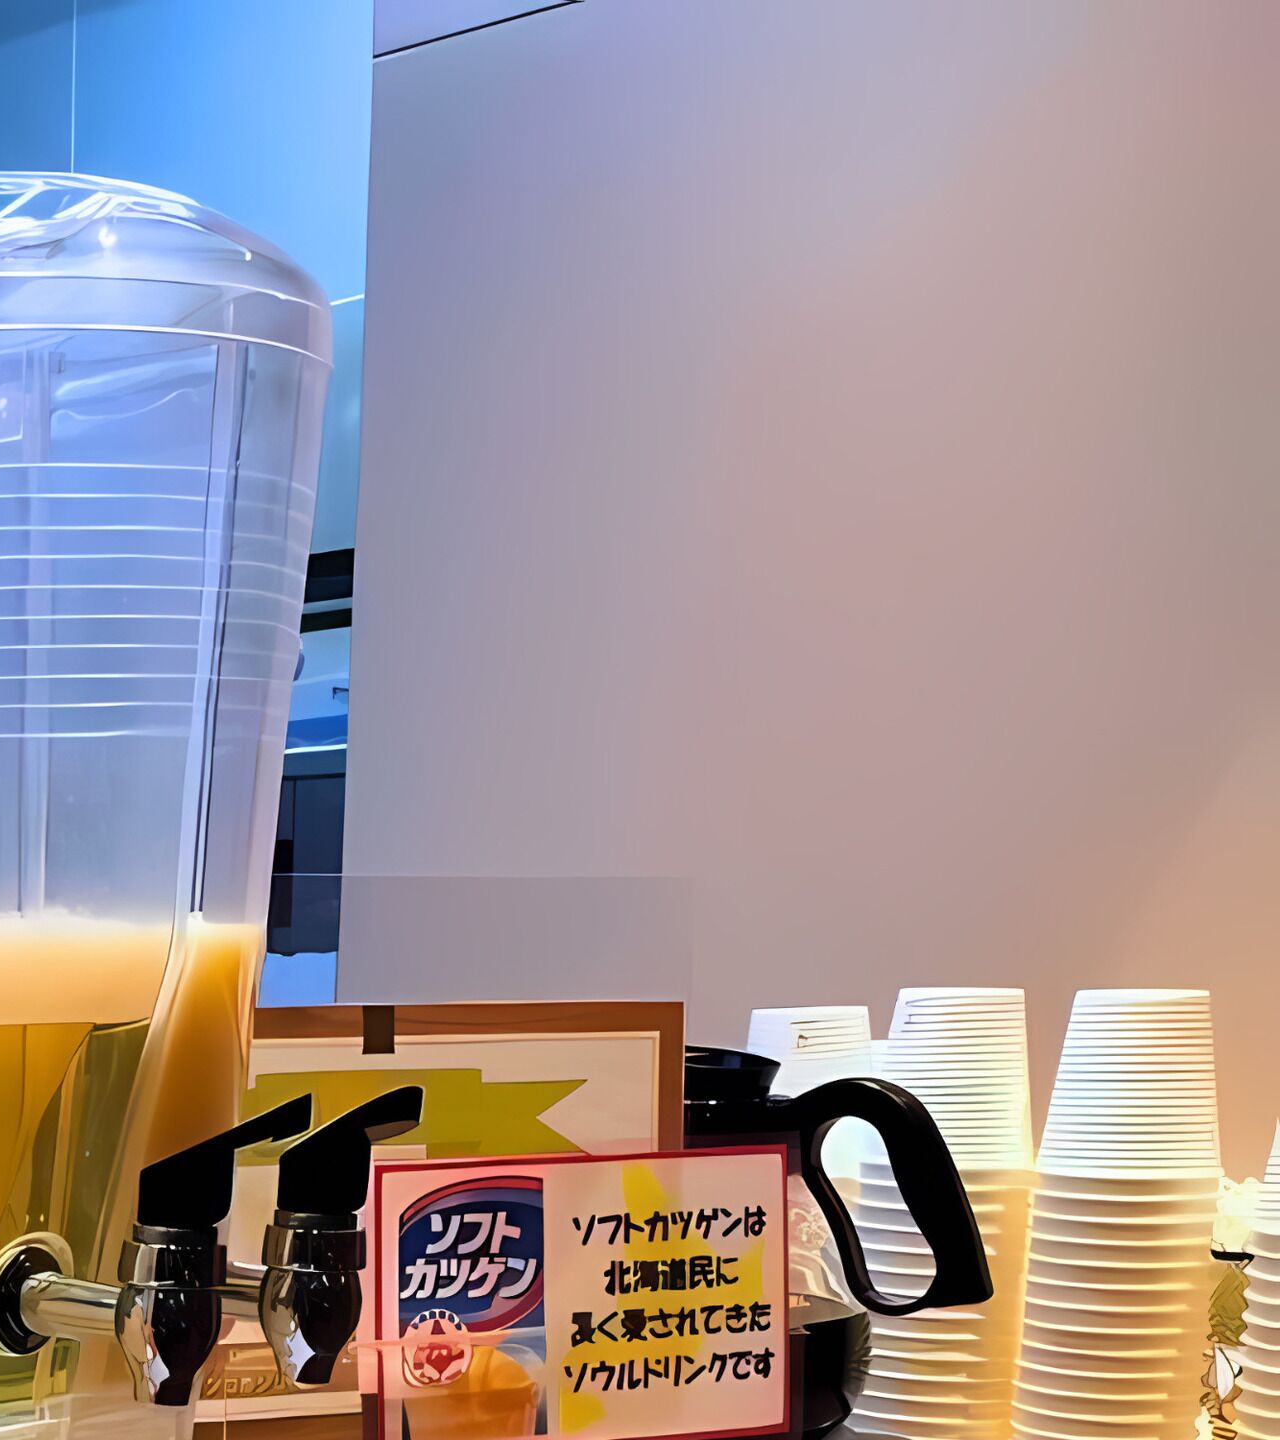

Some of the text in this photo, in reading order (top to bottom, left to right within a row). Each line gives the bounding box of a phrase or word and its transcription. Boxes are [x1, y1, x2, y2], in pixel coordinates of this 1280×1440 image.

[426, 1210, 521, 1255] ソフト
[572, 1206, 767, 1246] ソフトカツゲンは
[399, 1258, 536, 1300] カツゲン
[604, 1255, 739, 1296] 北海道民に
[563, 1347, 775, 1394] ソウルドリンクです
